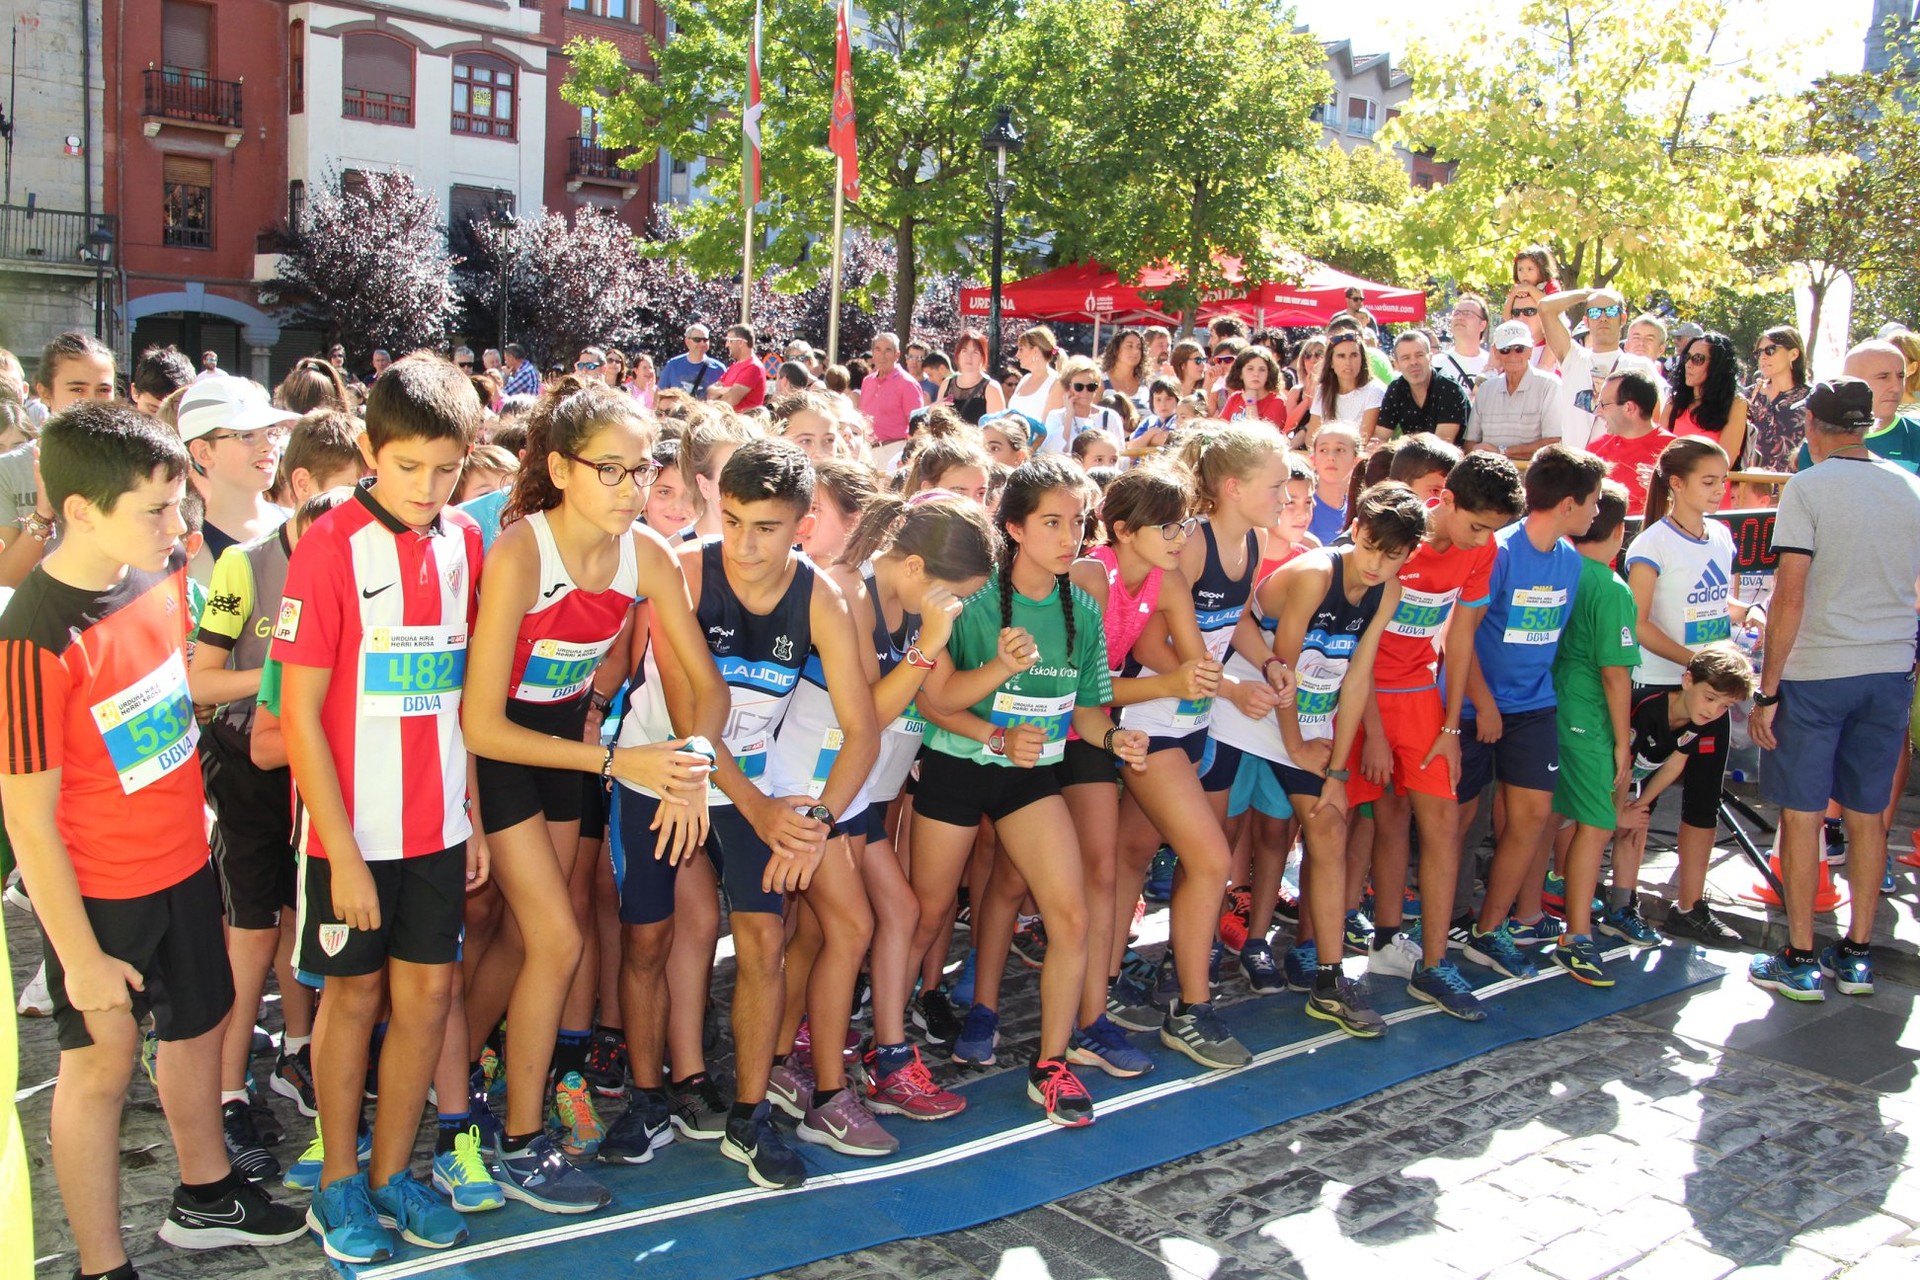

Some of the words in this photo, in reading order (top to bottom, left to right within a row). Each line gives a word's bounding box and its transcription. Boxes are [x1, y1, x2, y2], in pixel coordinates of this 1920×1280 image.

[969, 295, 1016, 311] URDÑA
[1398, 602, 1441, 625] 518
[1521, 606, 1561, 629] 530
[1397, 624, 1426, 635] BBVA
[1526, 632, 1550, 642] BBVA
[1696, 617, 1727, 642] 522
[388, 651, 455, 690] 482
[722, 664, 796, 687] LAUDIO
[1029, 665, 1058, 678] Eskola
[552, 682, 584, 699] BBV
[403, 695, 442, 713] BBVA
[904, 720, 926, 734] BBV
[1298, 714, 1327, 724] BBVA
[157, 735, 194, 771] BBVA
